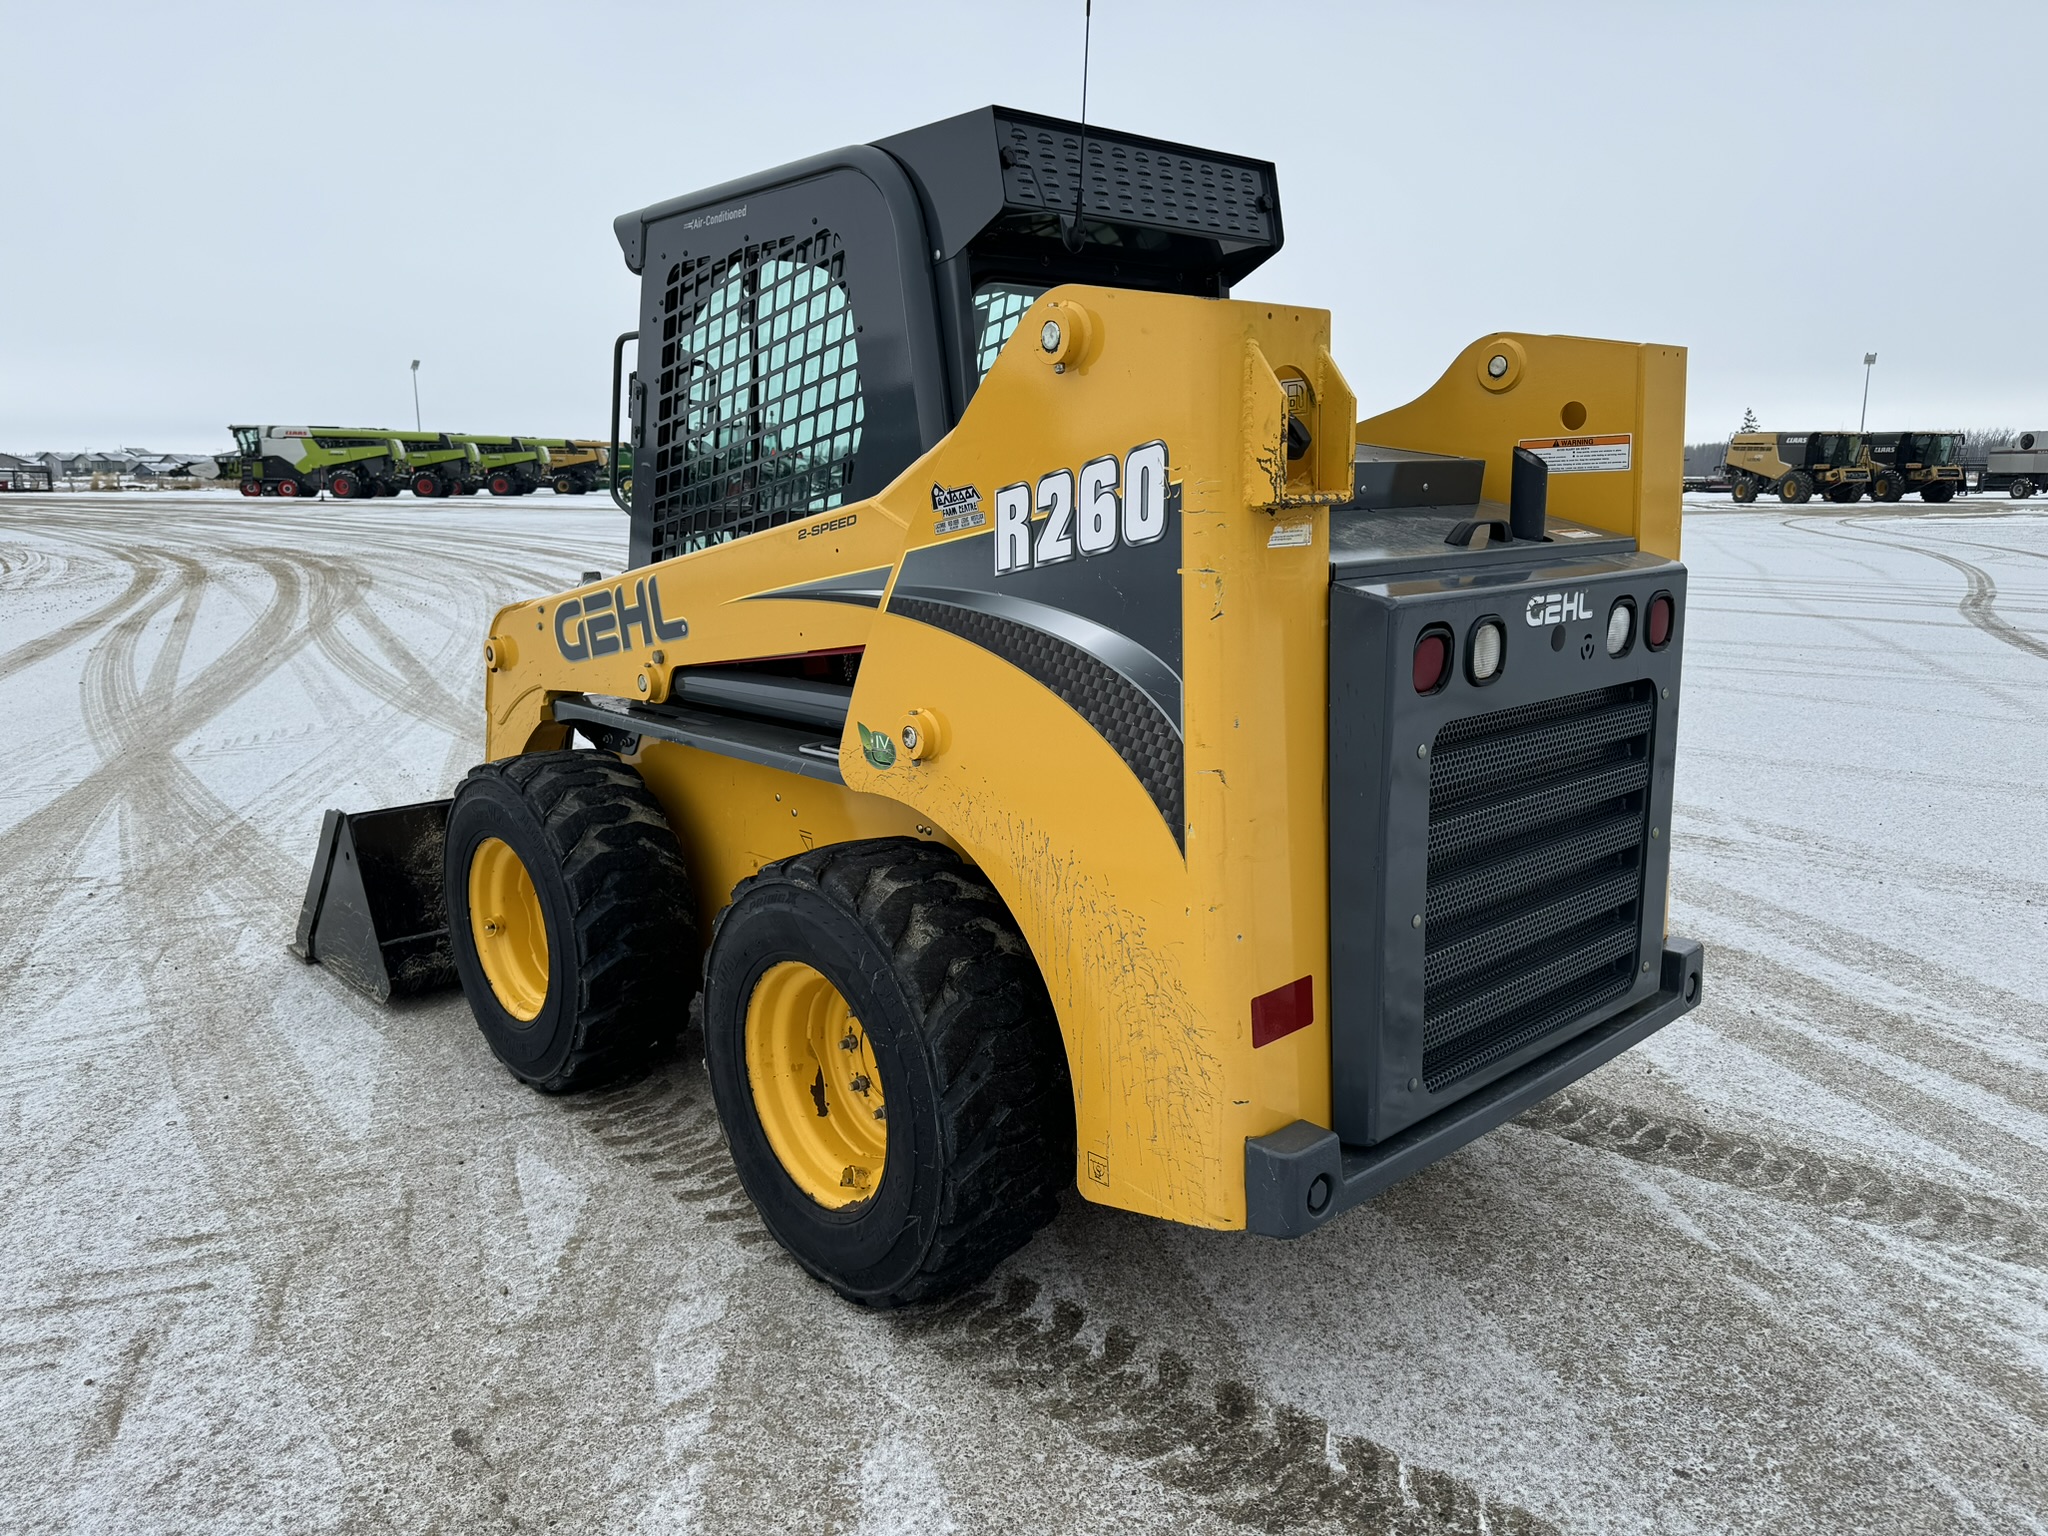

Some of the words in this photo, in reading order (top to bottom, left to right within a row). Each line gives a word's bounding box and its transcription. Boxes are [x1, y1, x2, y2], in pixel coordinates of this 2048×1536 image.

[693, 204, 747, 229] Air-Conditioned
[995, 438, 1169, 577] R260
[798, 514, 857, 540] 2-SPEED
[553, 573, 689, 663] GEHL
[1526, 592, 1593, 627] GEHL
[875, 735, 890, 750] IV
